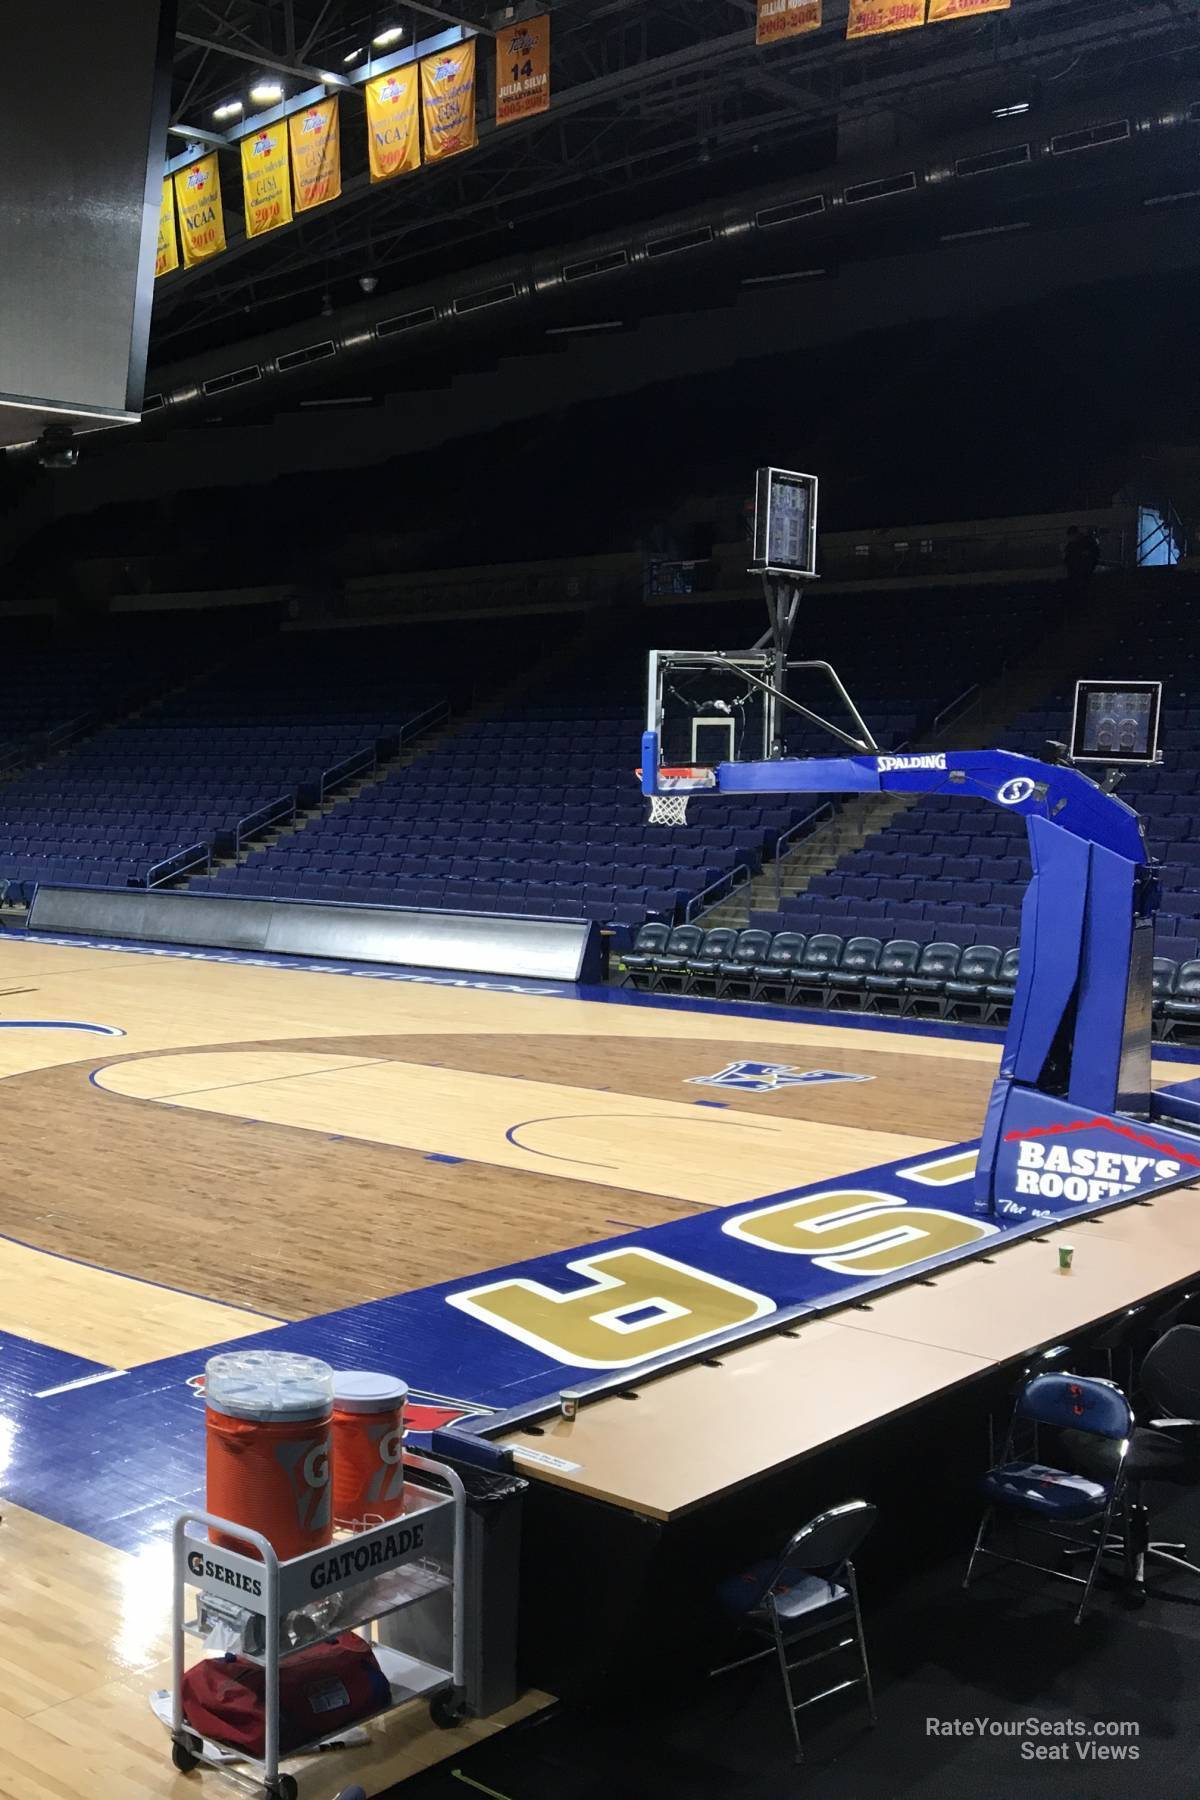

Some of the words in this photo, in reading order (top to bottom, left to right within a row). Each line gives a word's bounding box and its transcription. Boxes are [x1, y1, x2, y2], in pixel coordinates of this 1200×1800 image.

[499, 83, 521, 98] JULIA
[524, 72, 548, 88] SILVA
[511, 60, 533, 80] 14
[186, 207, 216, 231] NCAA
[877, 753, 948, 772] SPALDING
[1017, 1140, 1181, 1184] BASEY'S
[379, 1428, 401, 1465] G
[303, 1441, 329, 1488] G
[310, 1525, 425, 1590] GATORADE
